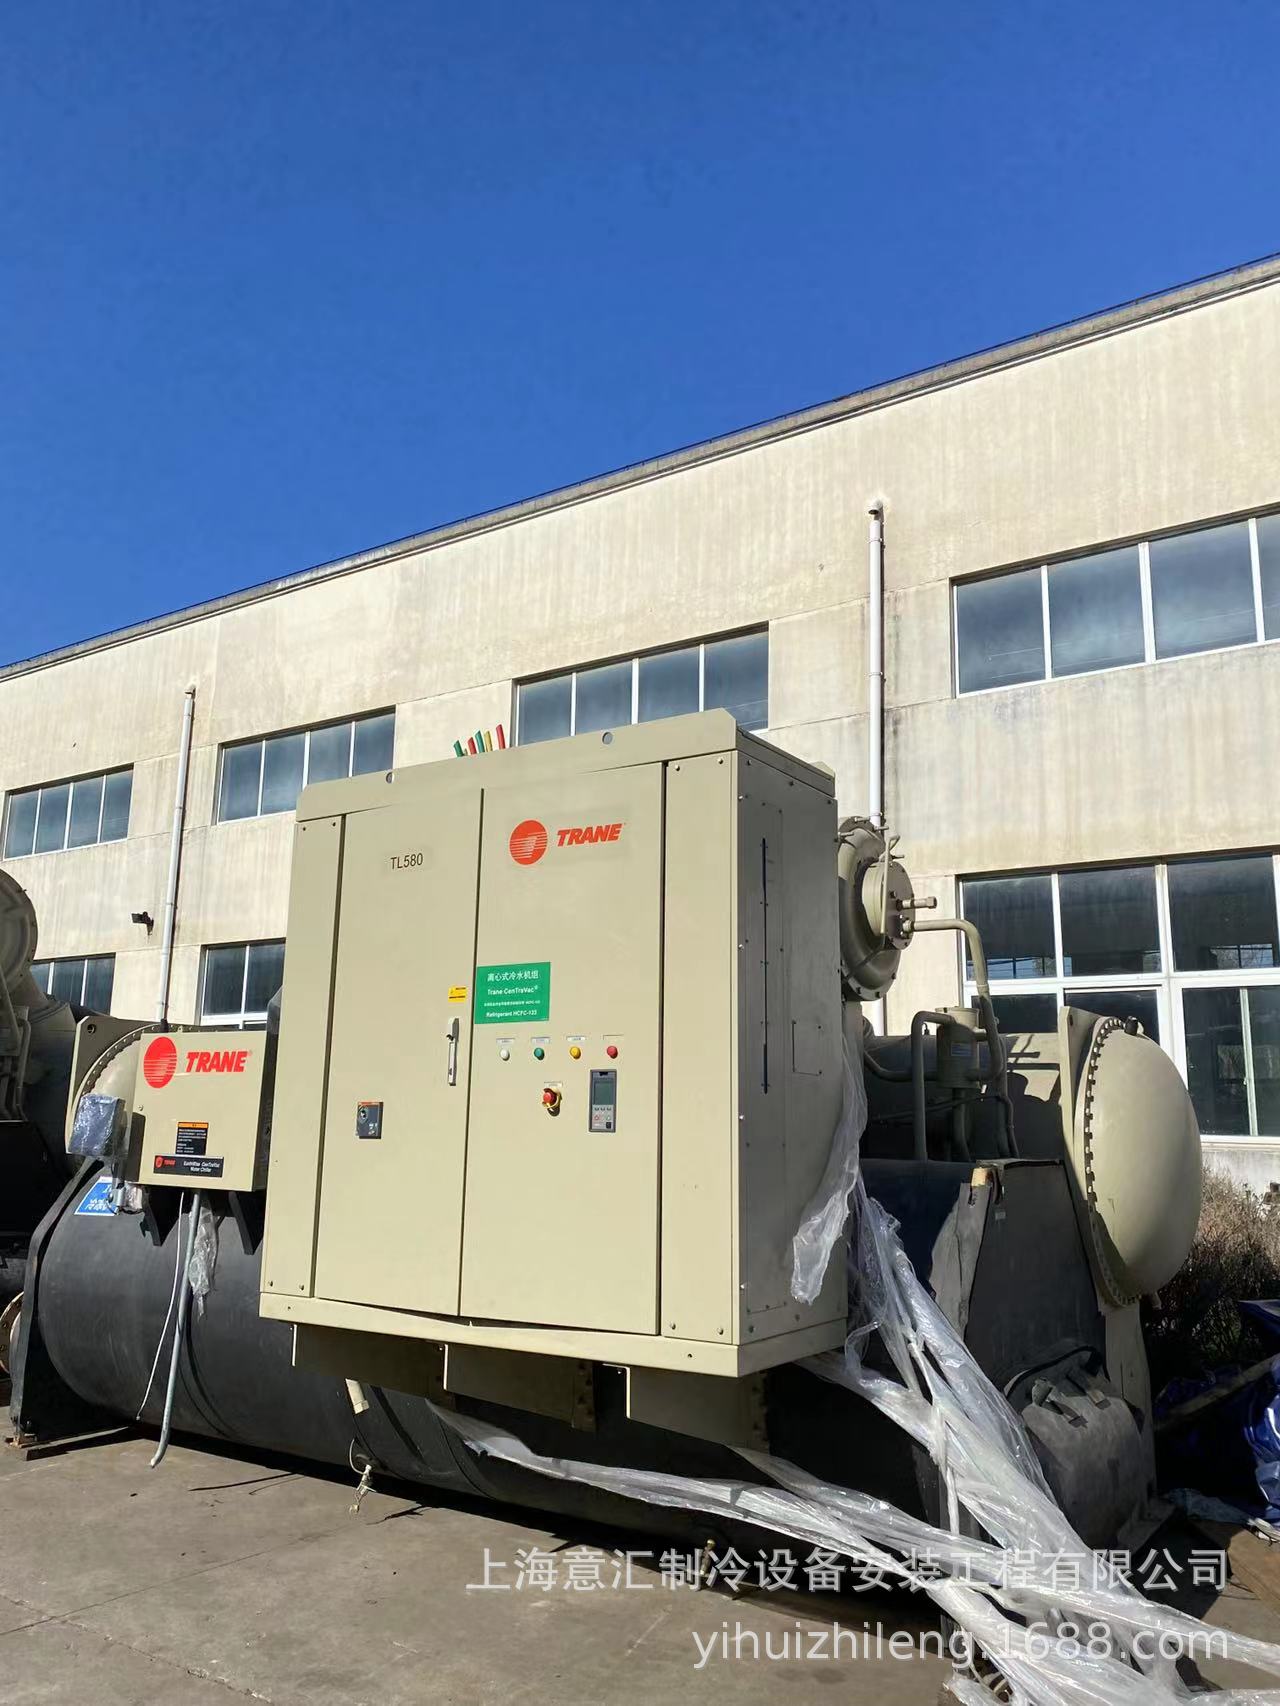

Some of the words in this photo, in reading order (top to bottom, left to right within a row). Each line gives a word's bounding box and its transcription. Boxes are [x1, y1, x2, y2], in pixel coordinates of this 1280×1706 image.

[557, 823, 622, 847] TRANE
[390, 853, 424, 870] TL580
[487, 970, 539, 982] 离心式冷水机组
[487, 988, 503, 996] Trane
[186, 1051, 249, 1073] TRANE
